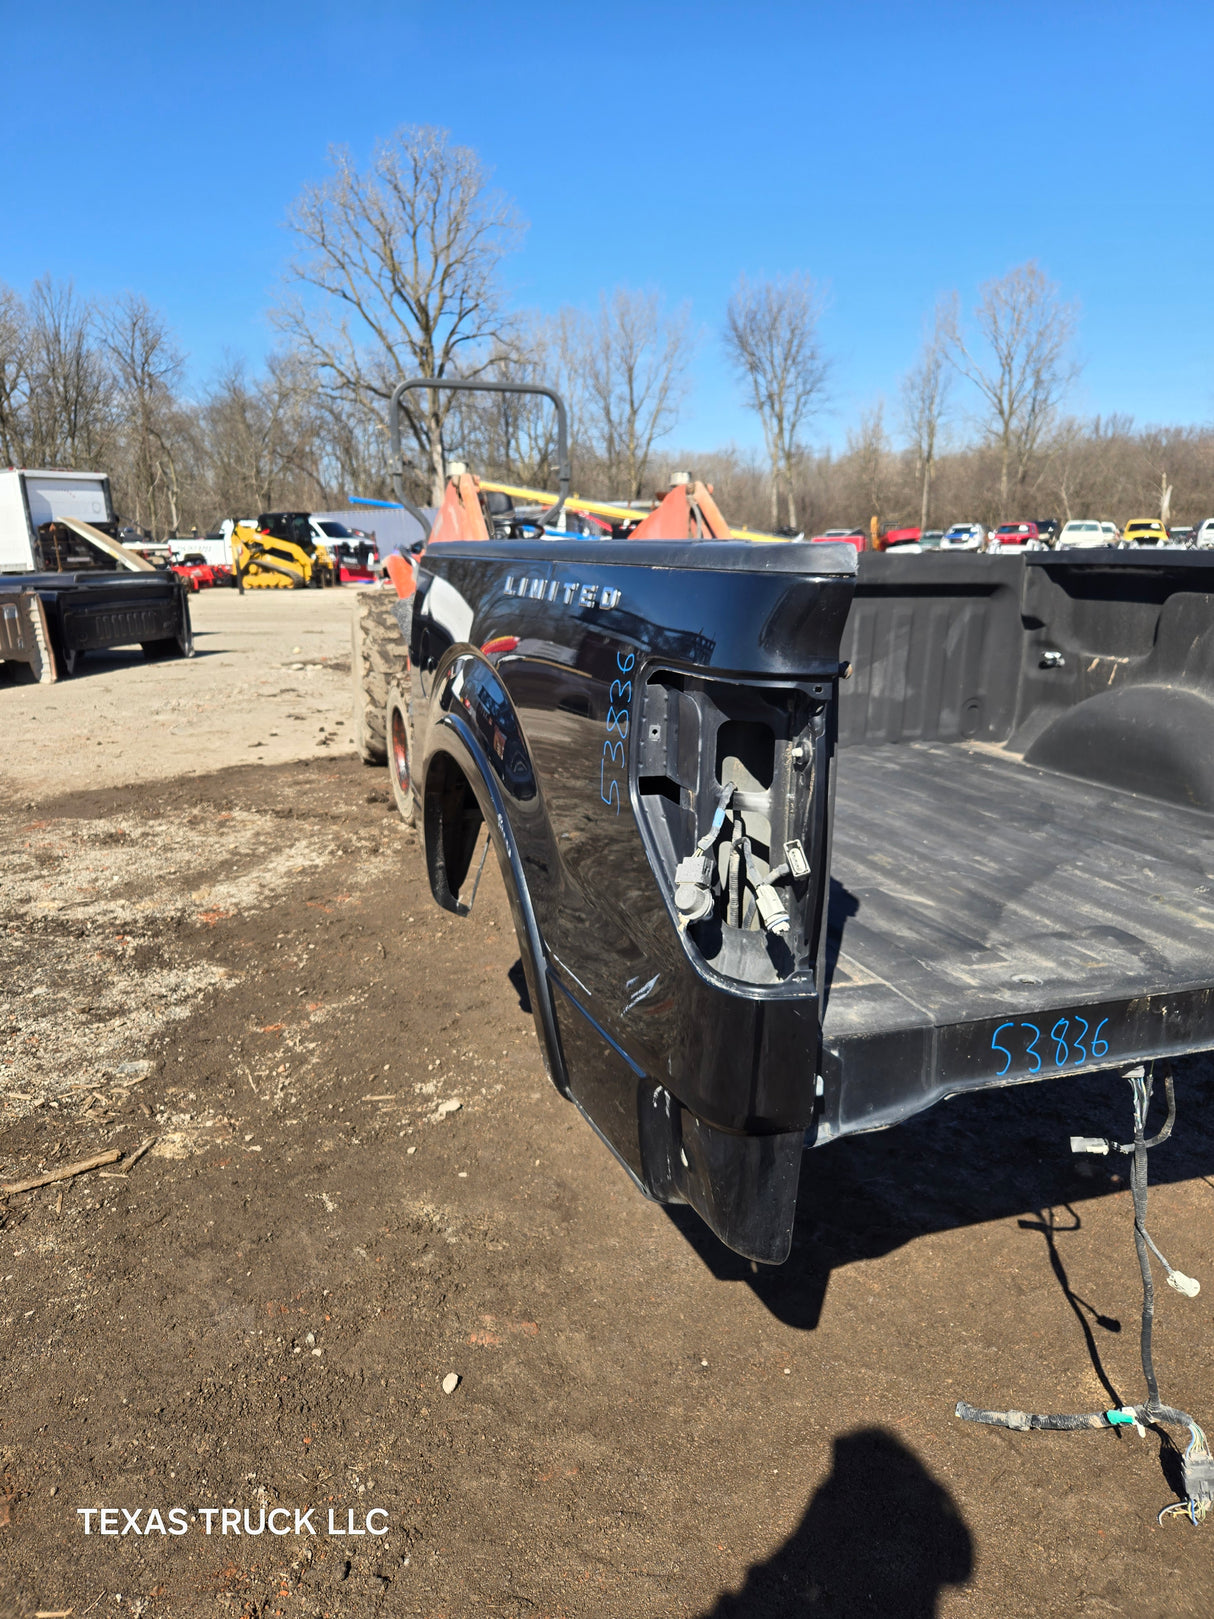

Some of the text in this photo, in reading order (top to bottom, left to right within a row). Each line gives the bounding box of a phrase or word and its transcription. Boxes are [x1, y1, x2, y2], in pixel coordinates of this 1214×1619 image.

[503, 575, 622, 611] LIMITED
[601, 651, 636, 817] 53836
[991, 1015, 1110, 1076] 53836
